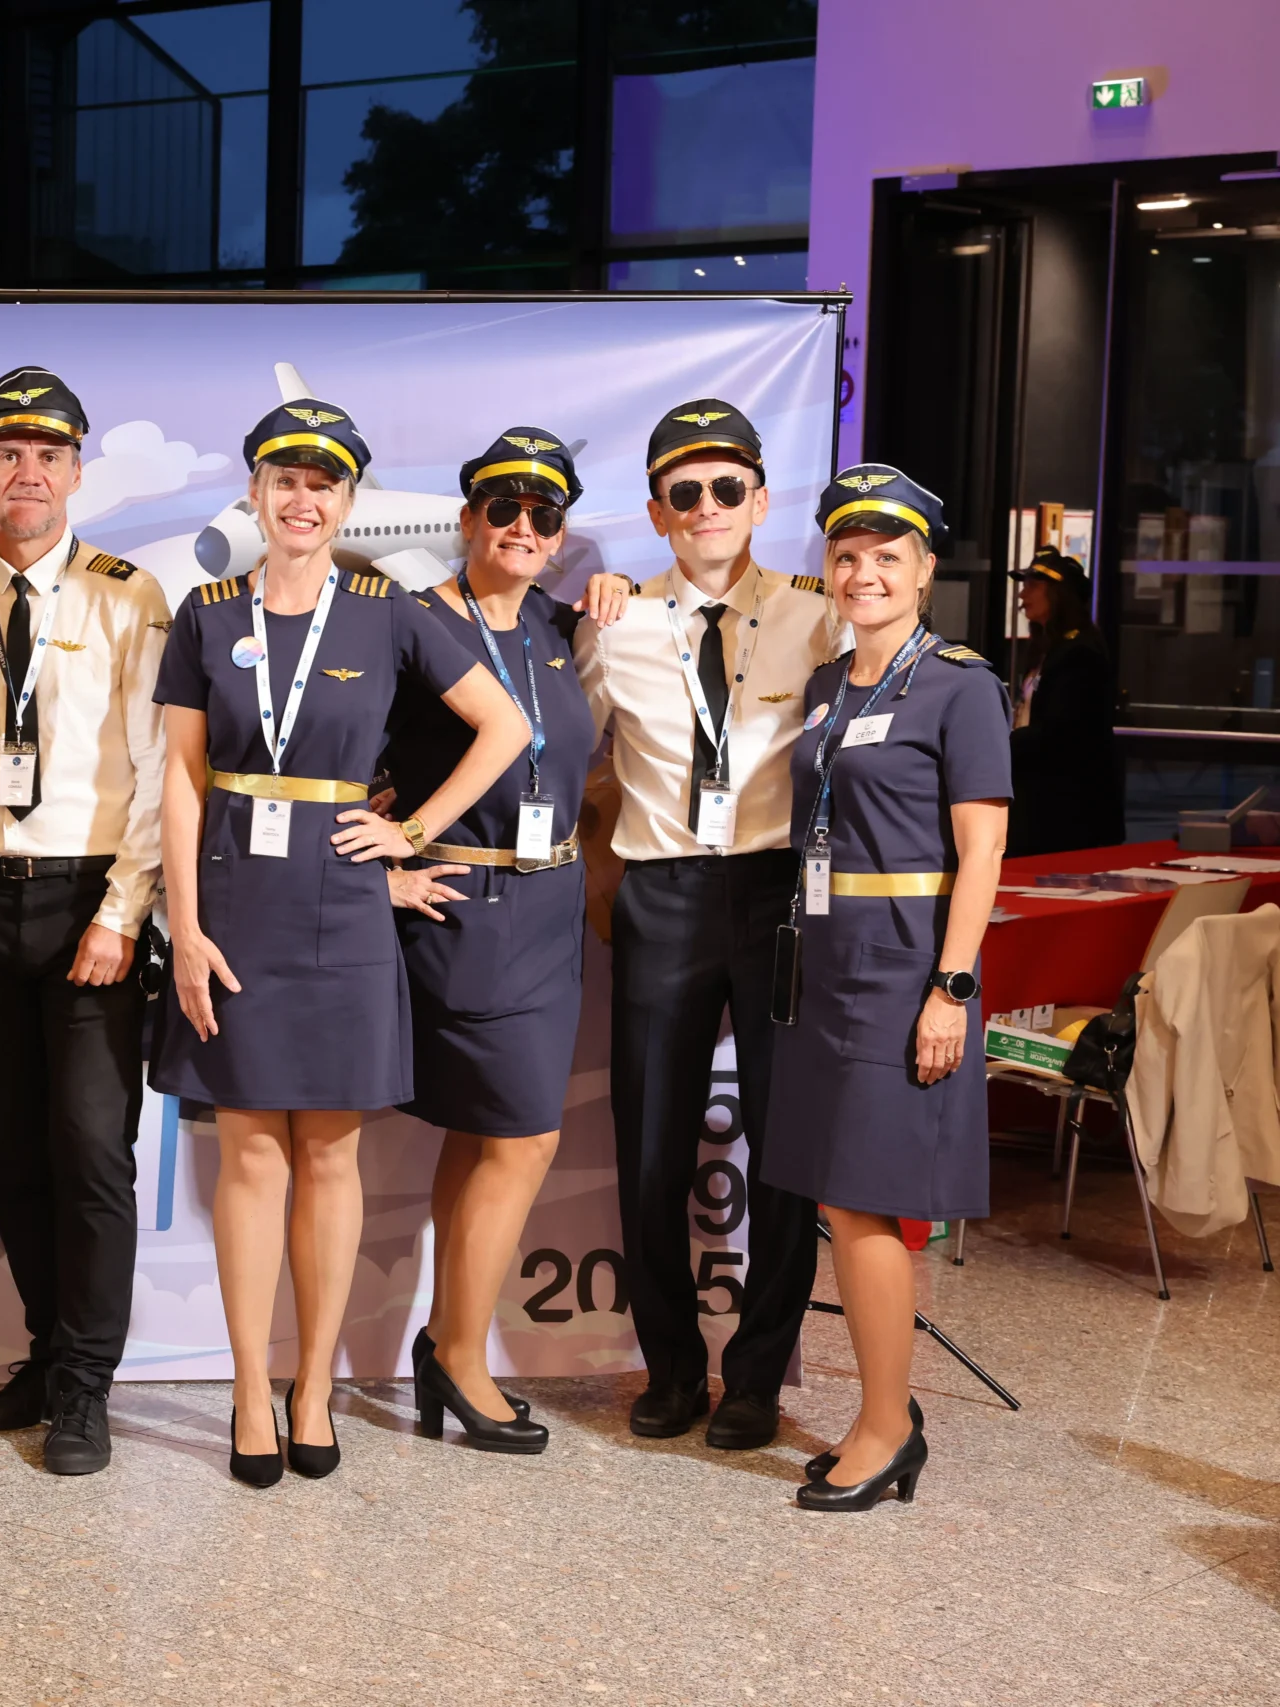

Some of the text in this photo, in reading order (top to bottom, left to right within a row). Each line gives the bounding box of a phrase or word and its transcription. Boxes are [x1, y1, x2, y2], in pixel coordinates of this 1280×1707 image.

[465, 592, 498, 656] #LESPRITPHARMACIEN
[526, 659, 542, 723] #LESPRITPHARMACIEN
[855, 730, 877, 739] CERP
[1029, 1052, 1065, 1068] NAVIGATOR
[692, 1159, 747, 1236] 9
[520, 1248, 745, 1324] 205
